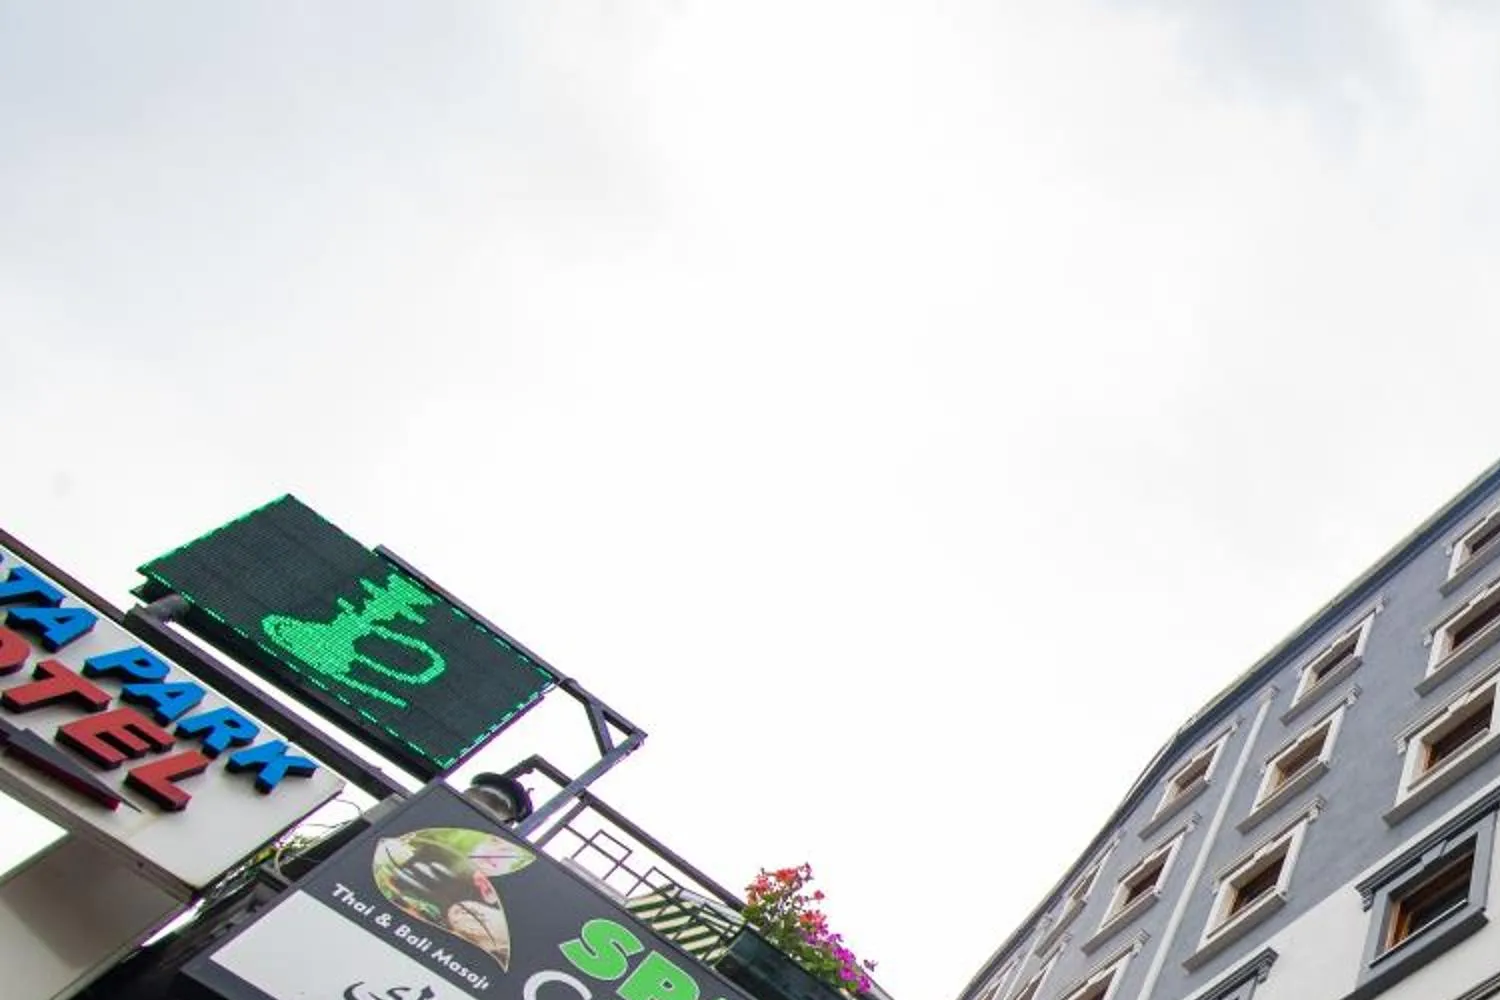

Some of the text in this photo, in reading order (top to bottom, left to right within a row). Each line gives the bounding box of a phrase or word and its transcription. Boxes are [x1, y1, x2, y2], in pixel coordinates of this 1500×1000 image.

[0, 553, 319, 795] TA PARK
[332, 883, 375, 916] Thai
[374, 913, 393, 929] &
[394, 924, 432, 952] Bali
